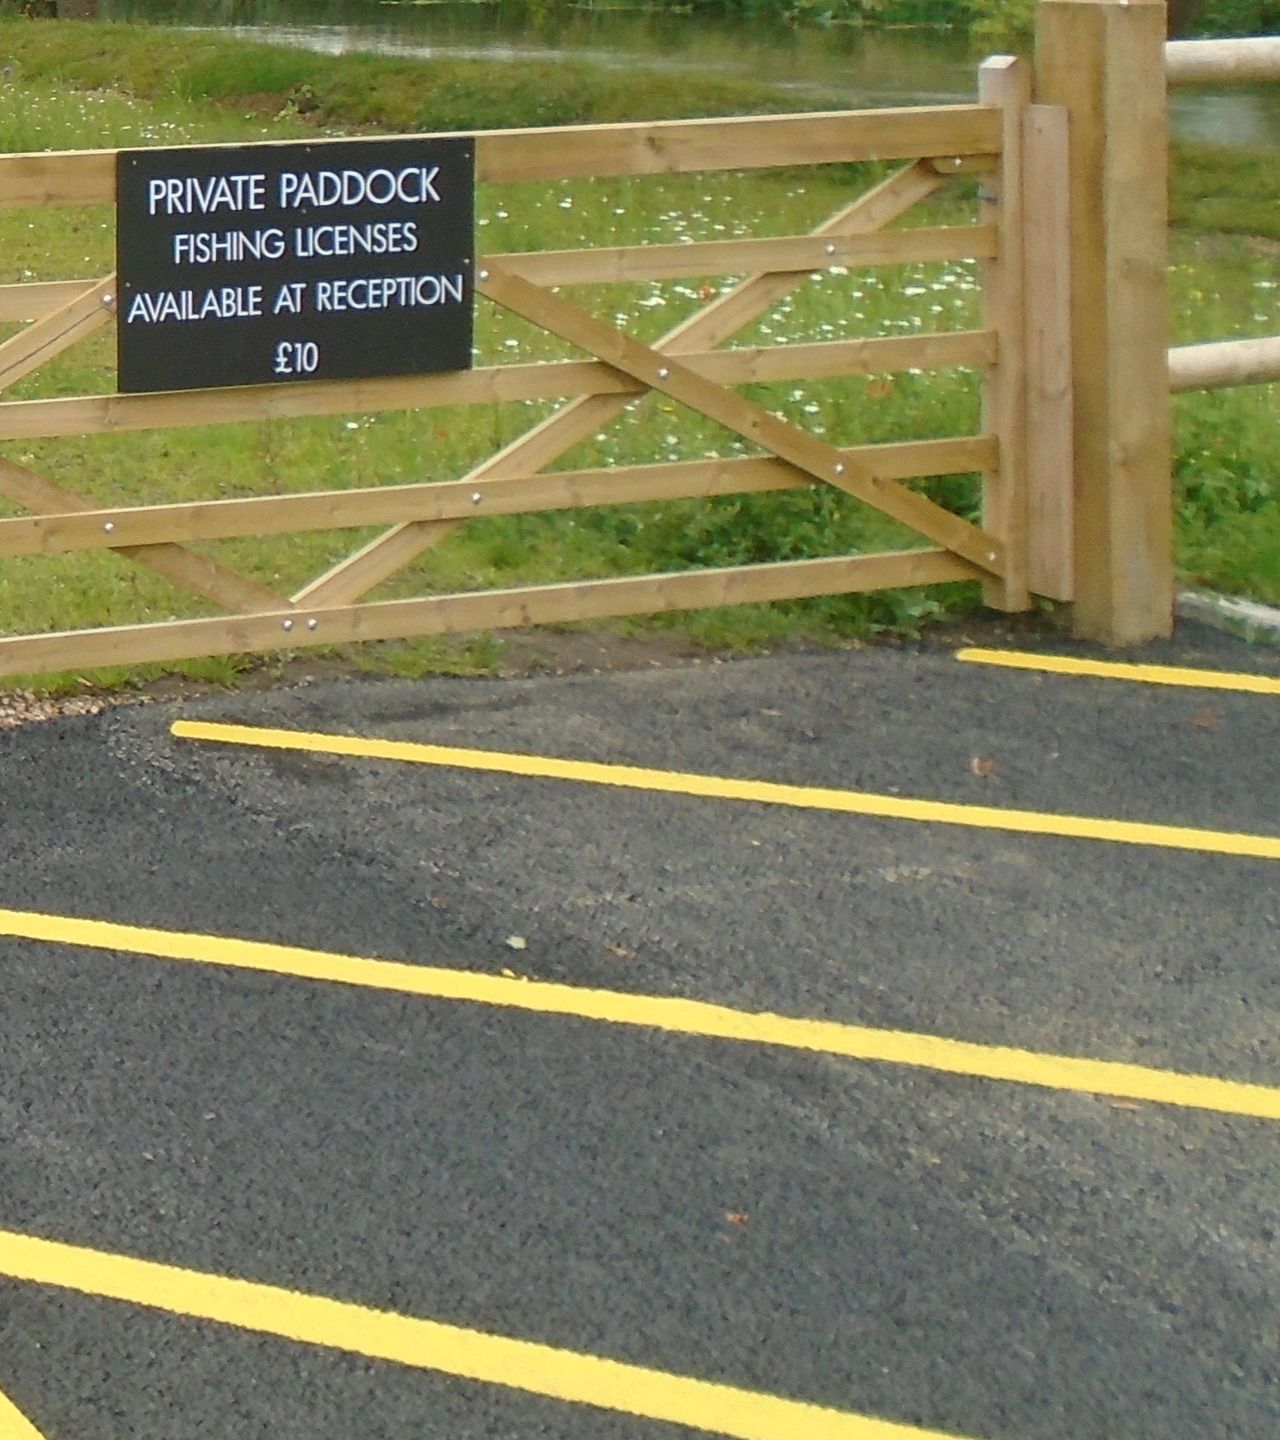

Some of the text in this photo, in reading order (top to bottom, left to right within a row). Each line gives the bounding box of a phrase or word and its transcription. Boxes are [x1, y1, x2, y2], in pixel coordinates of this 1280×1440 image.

[149, 166, 441, 216] PRIVATE PADDOCK
[174, 221, 418, 264] FISHING LICENSES
[127, 274, 463, 324] AVAILABLE AT RECEPTION
[274, 341, 319, 374] £10
